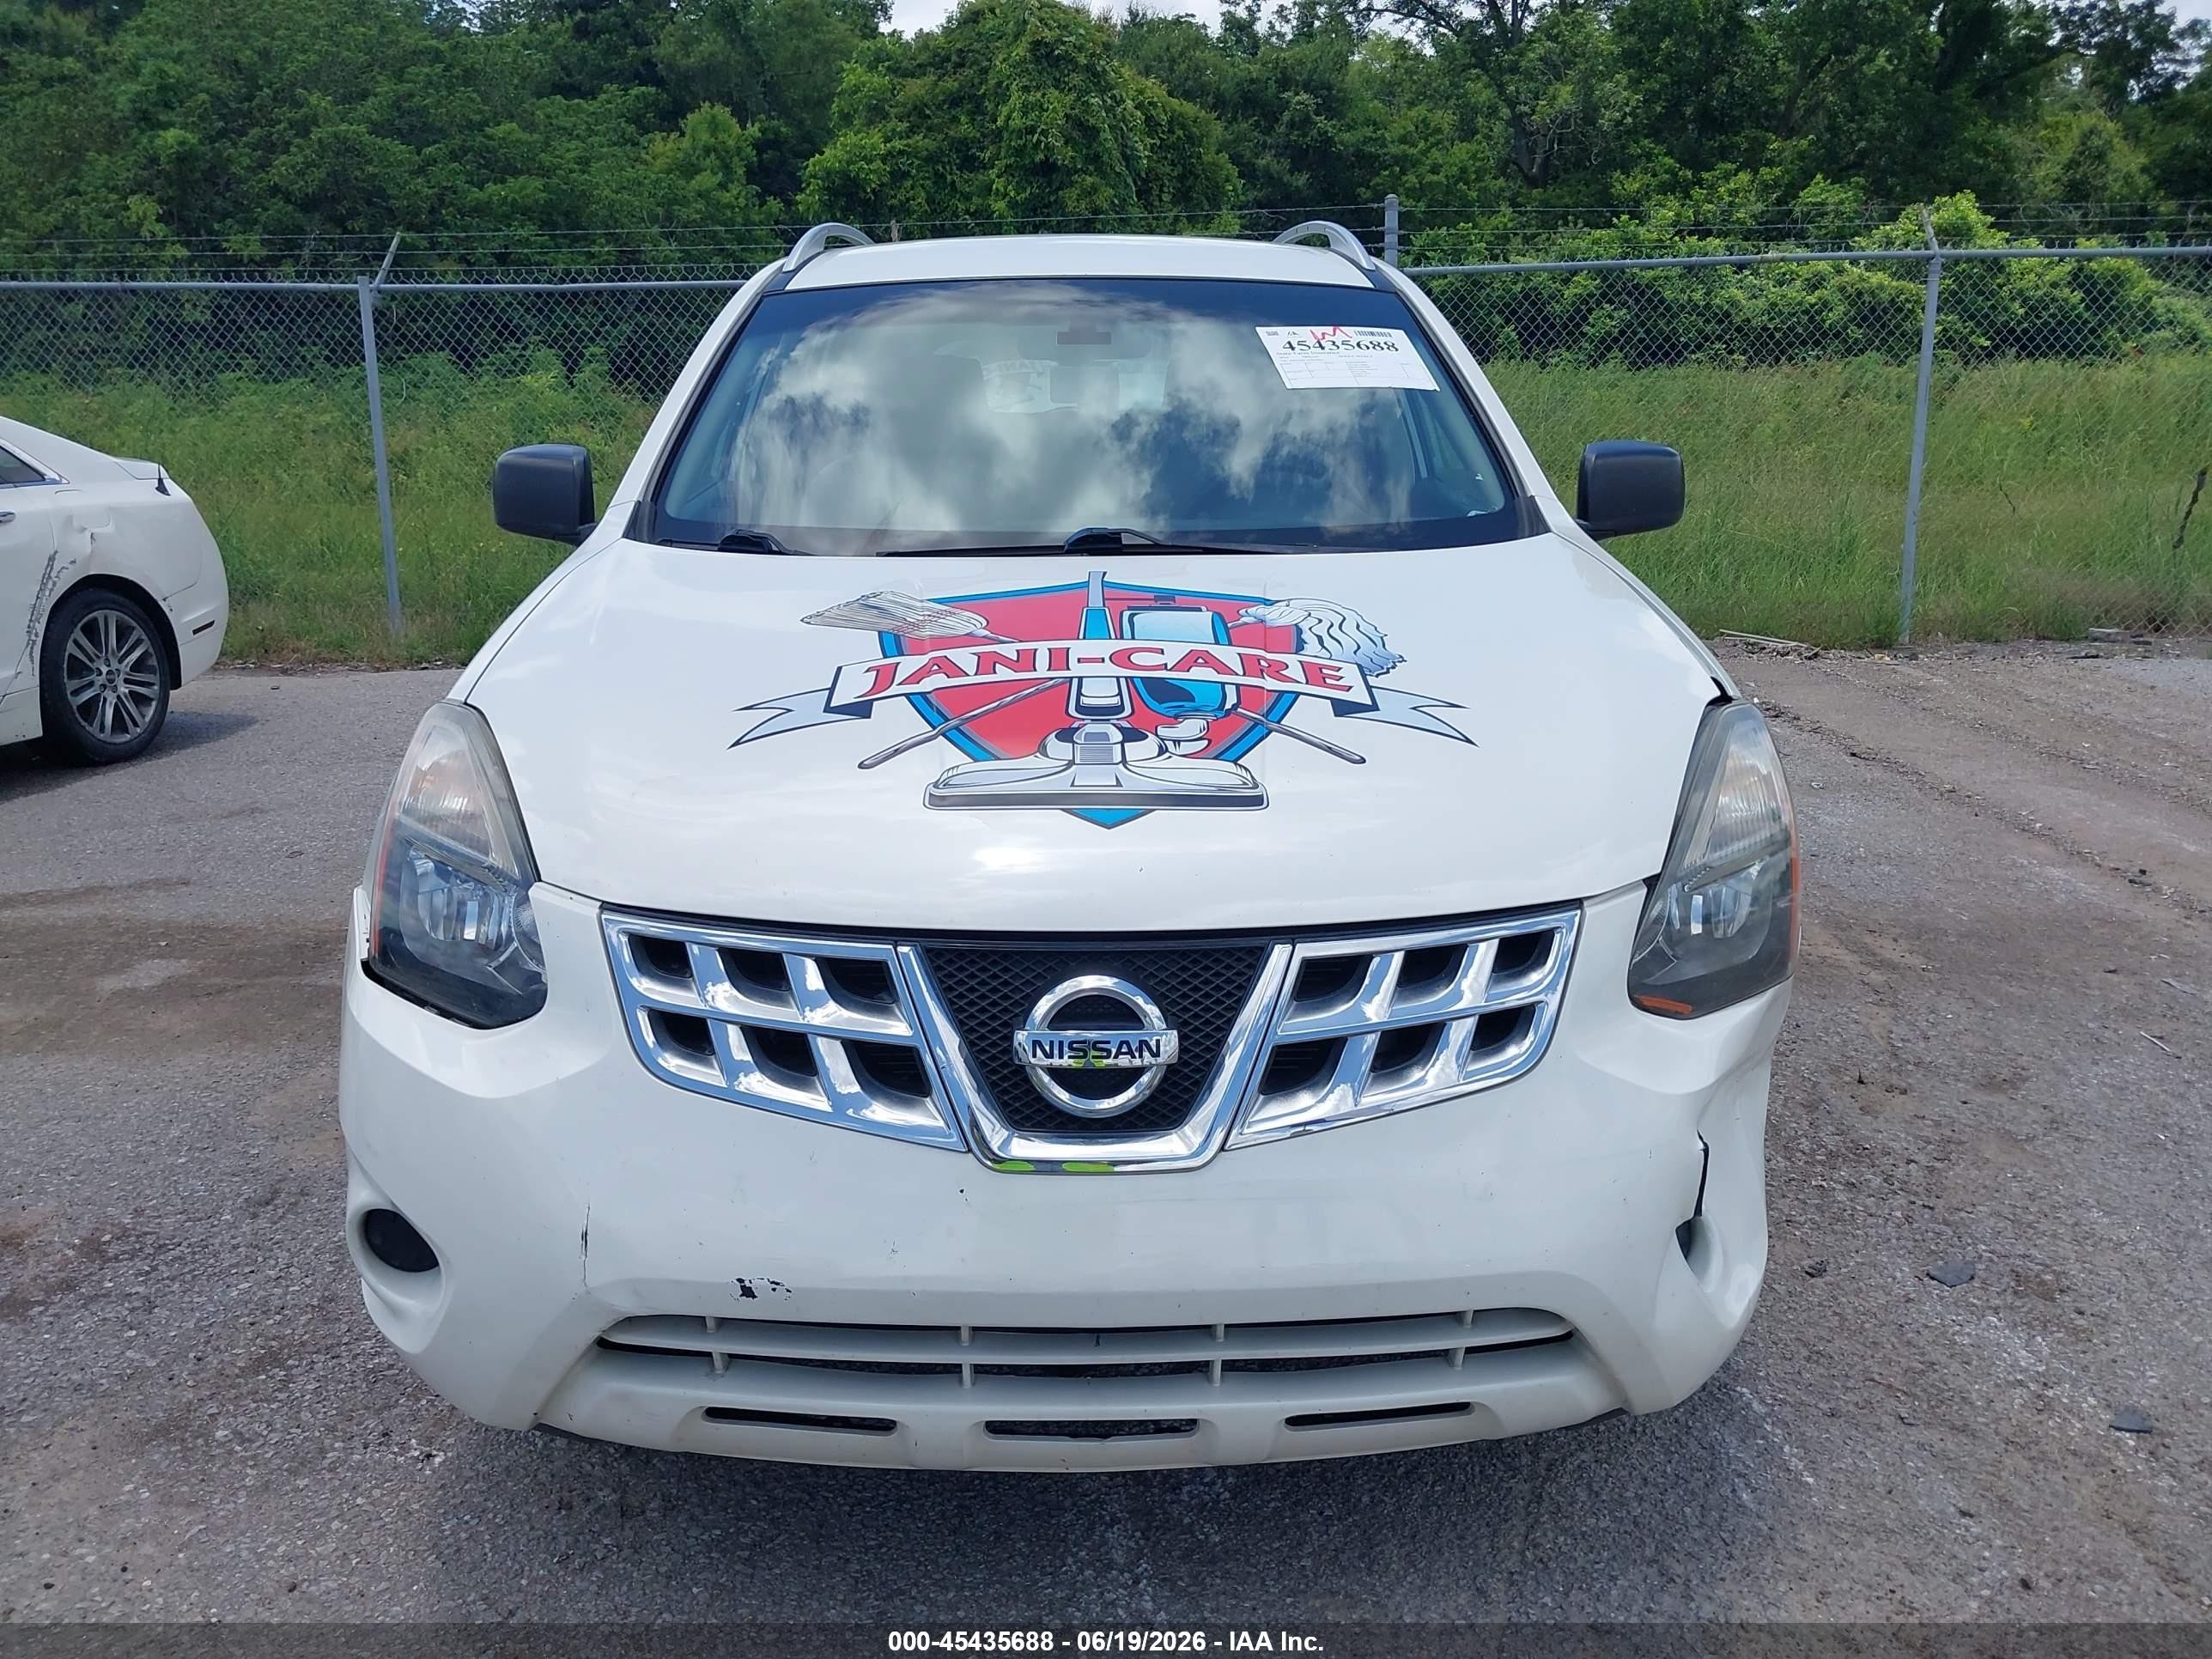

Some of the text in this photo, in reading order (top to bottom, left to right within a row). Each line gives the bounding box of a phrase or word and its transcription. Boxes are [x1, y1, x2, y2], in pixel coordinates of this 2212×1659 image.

[1282, 340, 1400, 352] 45435688
[855, 646, 1357, 698] JANI-CARE
[1031, 1038, 1161, 1060] NISSAN
